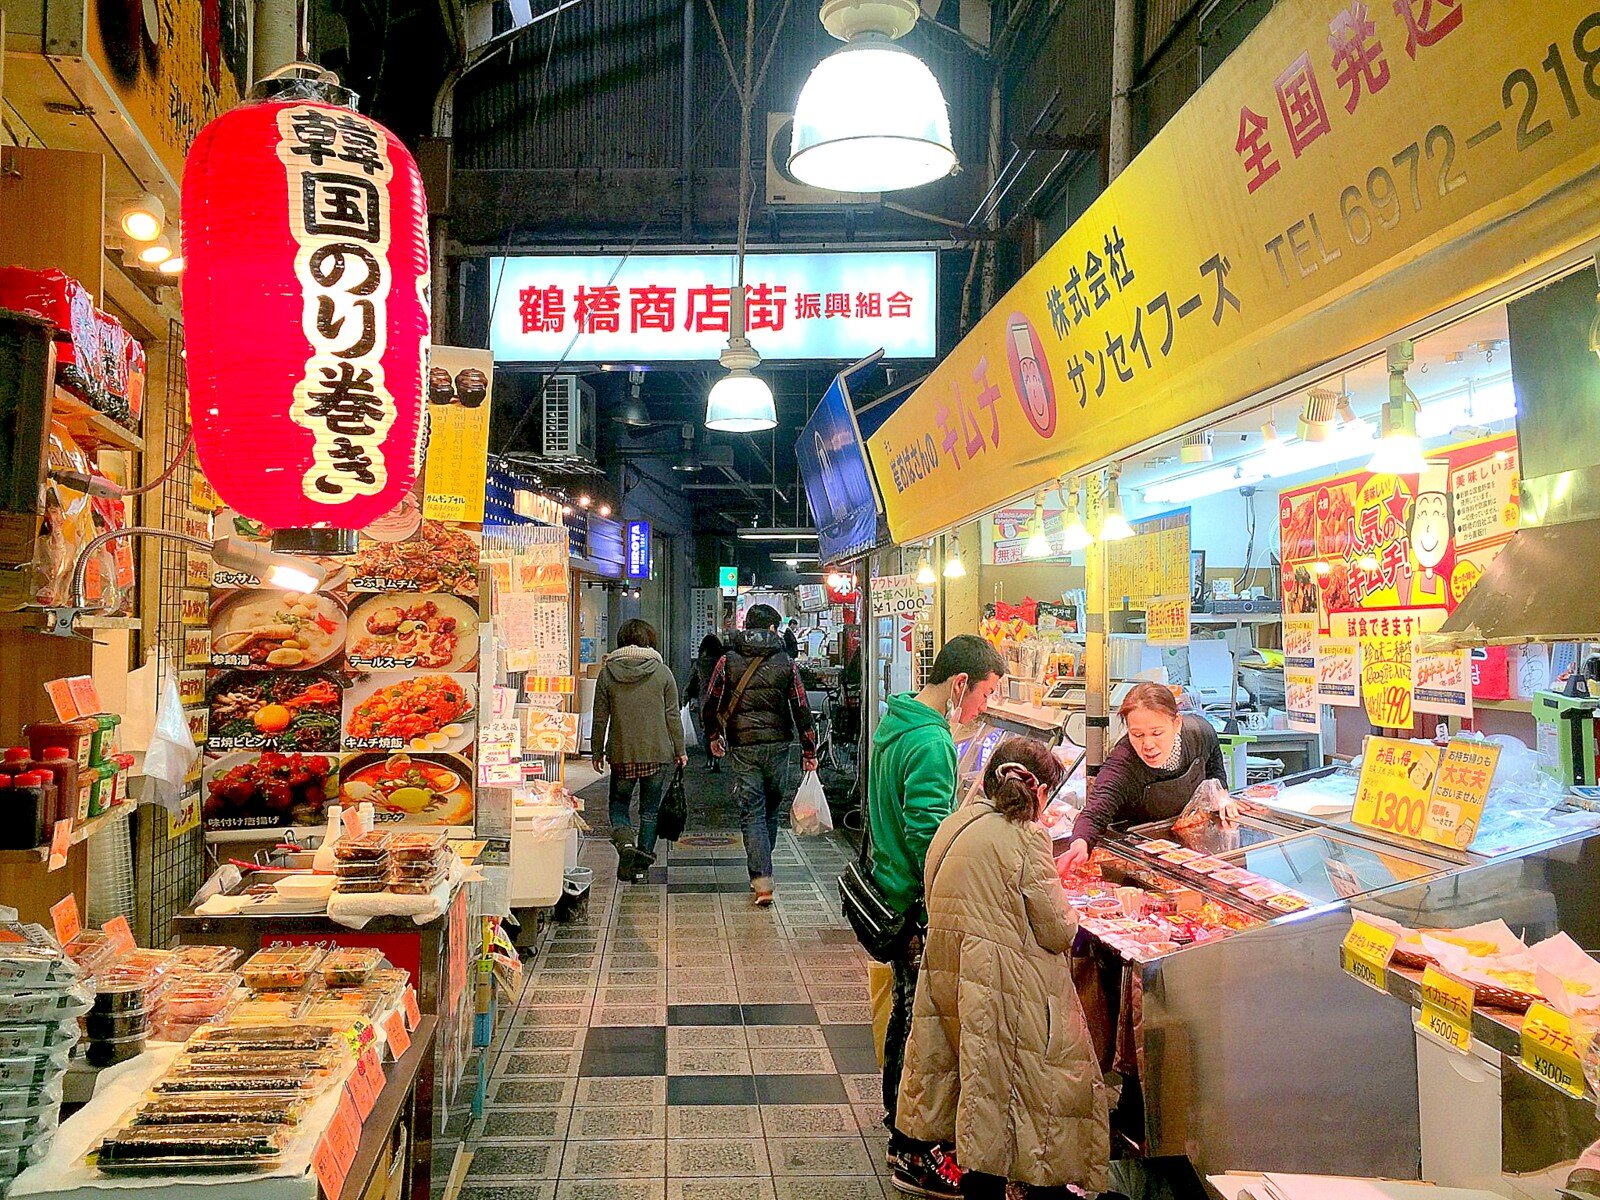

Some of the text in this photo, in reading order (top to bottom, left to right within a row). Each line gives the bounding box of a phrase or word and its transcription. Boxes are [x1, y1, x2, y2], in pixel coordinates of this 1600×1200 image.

[1265, 213, 1342, 288] TEL
[1046, 225, 1135, 342] 株式会社
[290, 109, 385, 494] 韓国のり巻き
[518, 283, 914, 334] 鶴橋商店街 振興組合
[1067, 253, 1241, 410] サンセイフーズ
[935, 355, 1001, 471] キムチ
[630, 524, 640, 574] HIROTA
[1344, 506, 1397, 562] 人気の
[351, 577, 419, 591] つぶ貝ムチム
[871, 574, 915, 591] アウトレット
[1348, 616, 1421, 638] 試食できます!
[349, 655, 419, 670] テールスープ
[345, 737, 405, 750] キムチ焼飯
[1375, 747, 1412, 767] お買い得
[1448, 750, 1491, 767] お持ち帰りも
[1442, 764, 1487, 790] 大丈夫
[1425, 984, 1468, 1018] イカチヂミ
[1430, 1014, 1461, 1045] ¥500円
[1534, 1055, 1573, 1087] ¥300円
